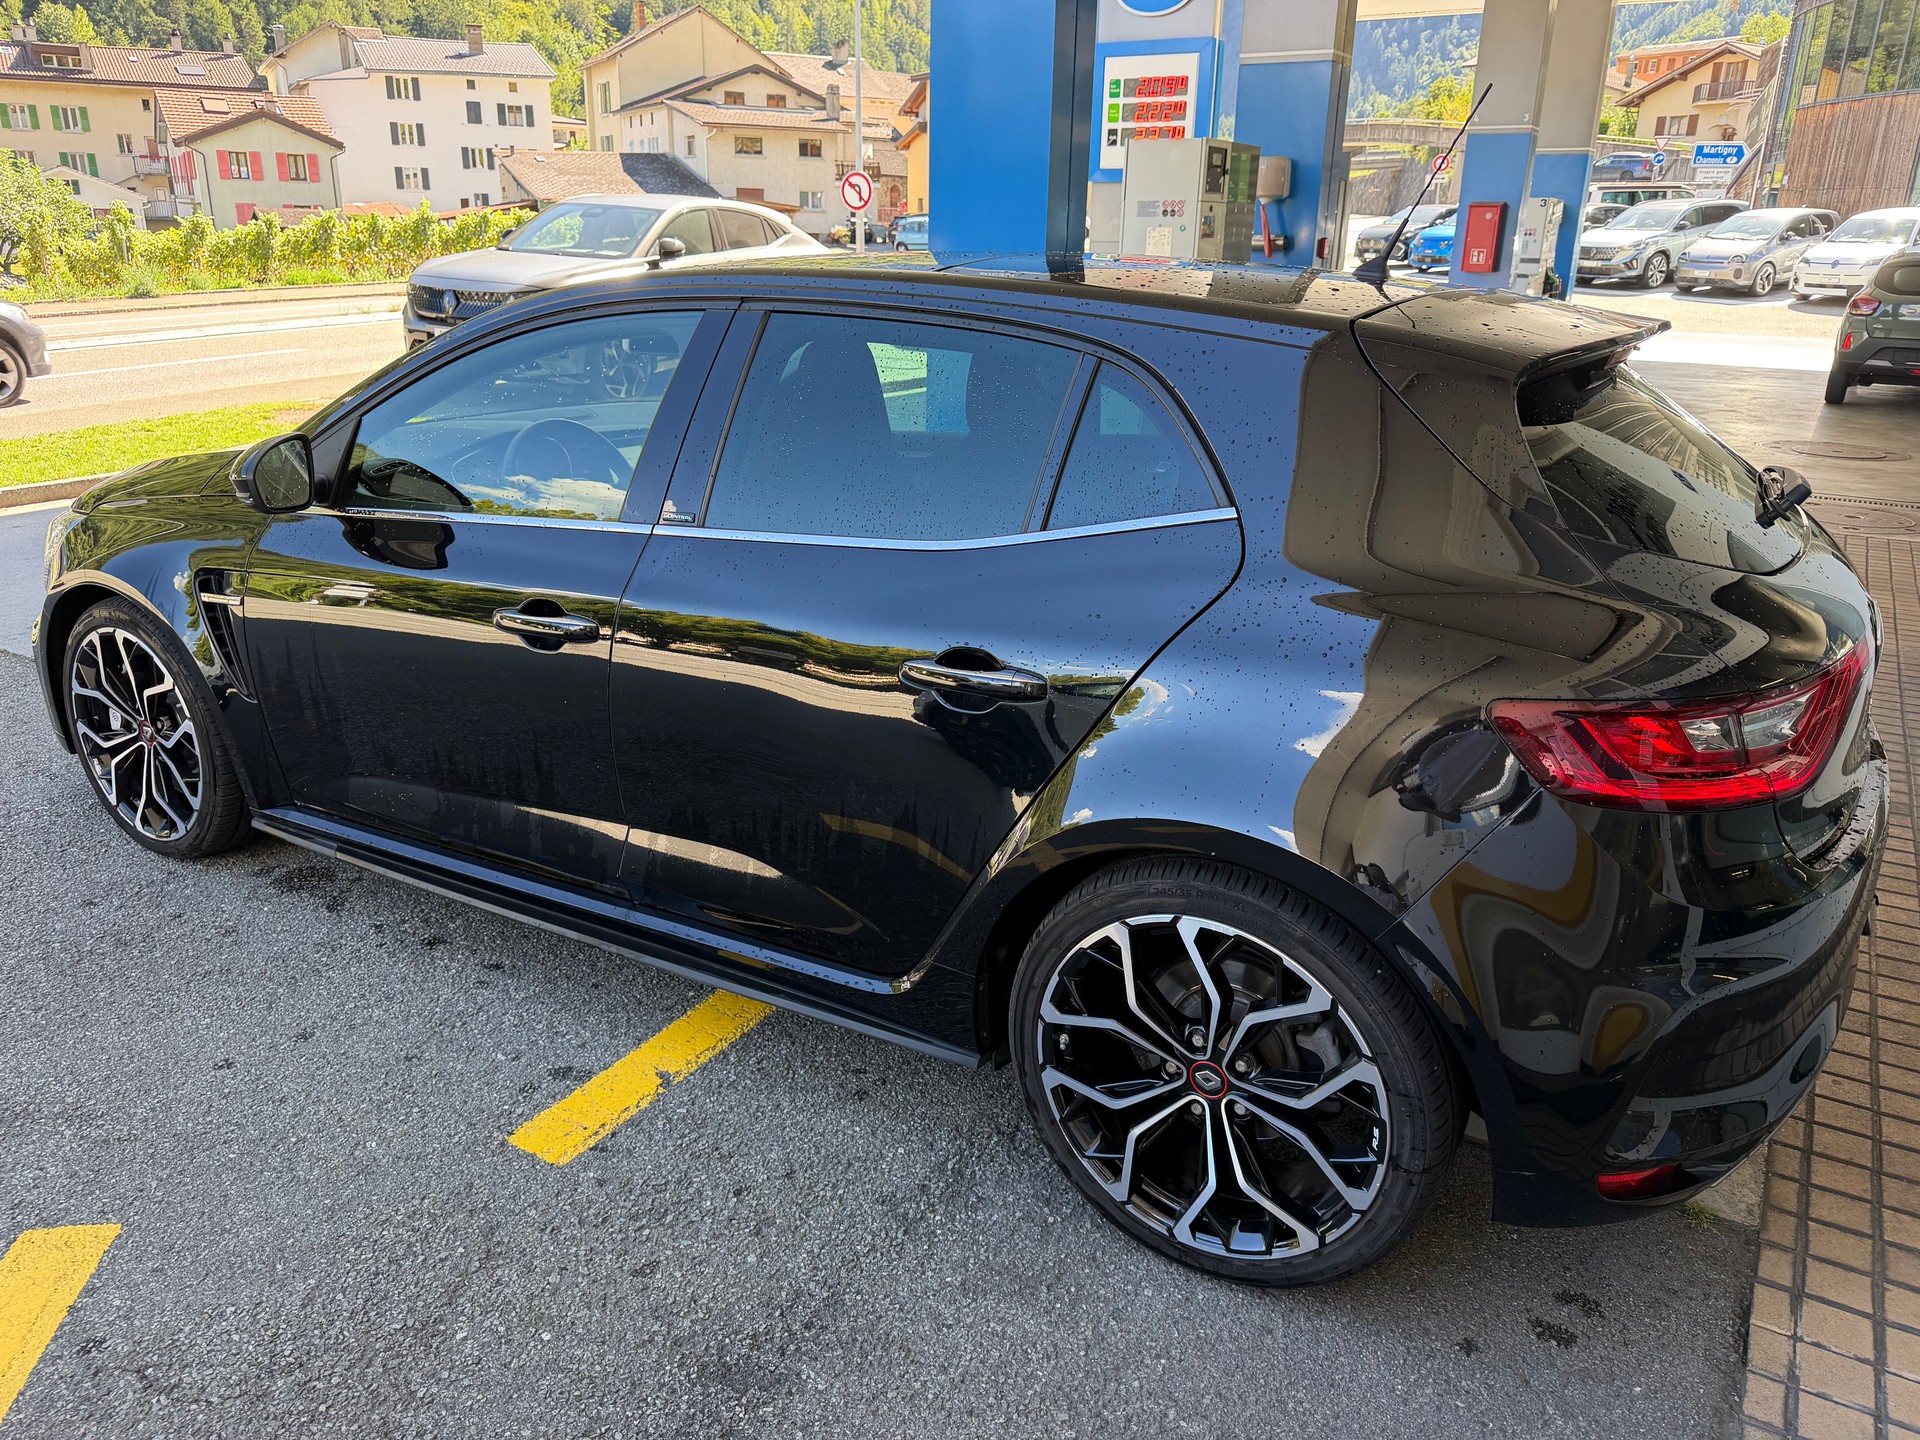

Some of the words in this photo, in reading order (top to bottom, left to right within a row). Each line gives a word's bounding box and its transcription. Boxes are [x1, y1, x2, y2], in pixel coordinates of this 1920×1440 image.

[1523, 113, 1530, 121] 3
[1702, 145, 1738, 156] Martigny
[1695, 156, 1724, 164] Chamonix
[1540, 199, 1547, 207] 3
[1152, 887, 1192, 898] 245/35
